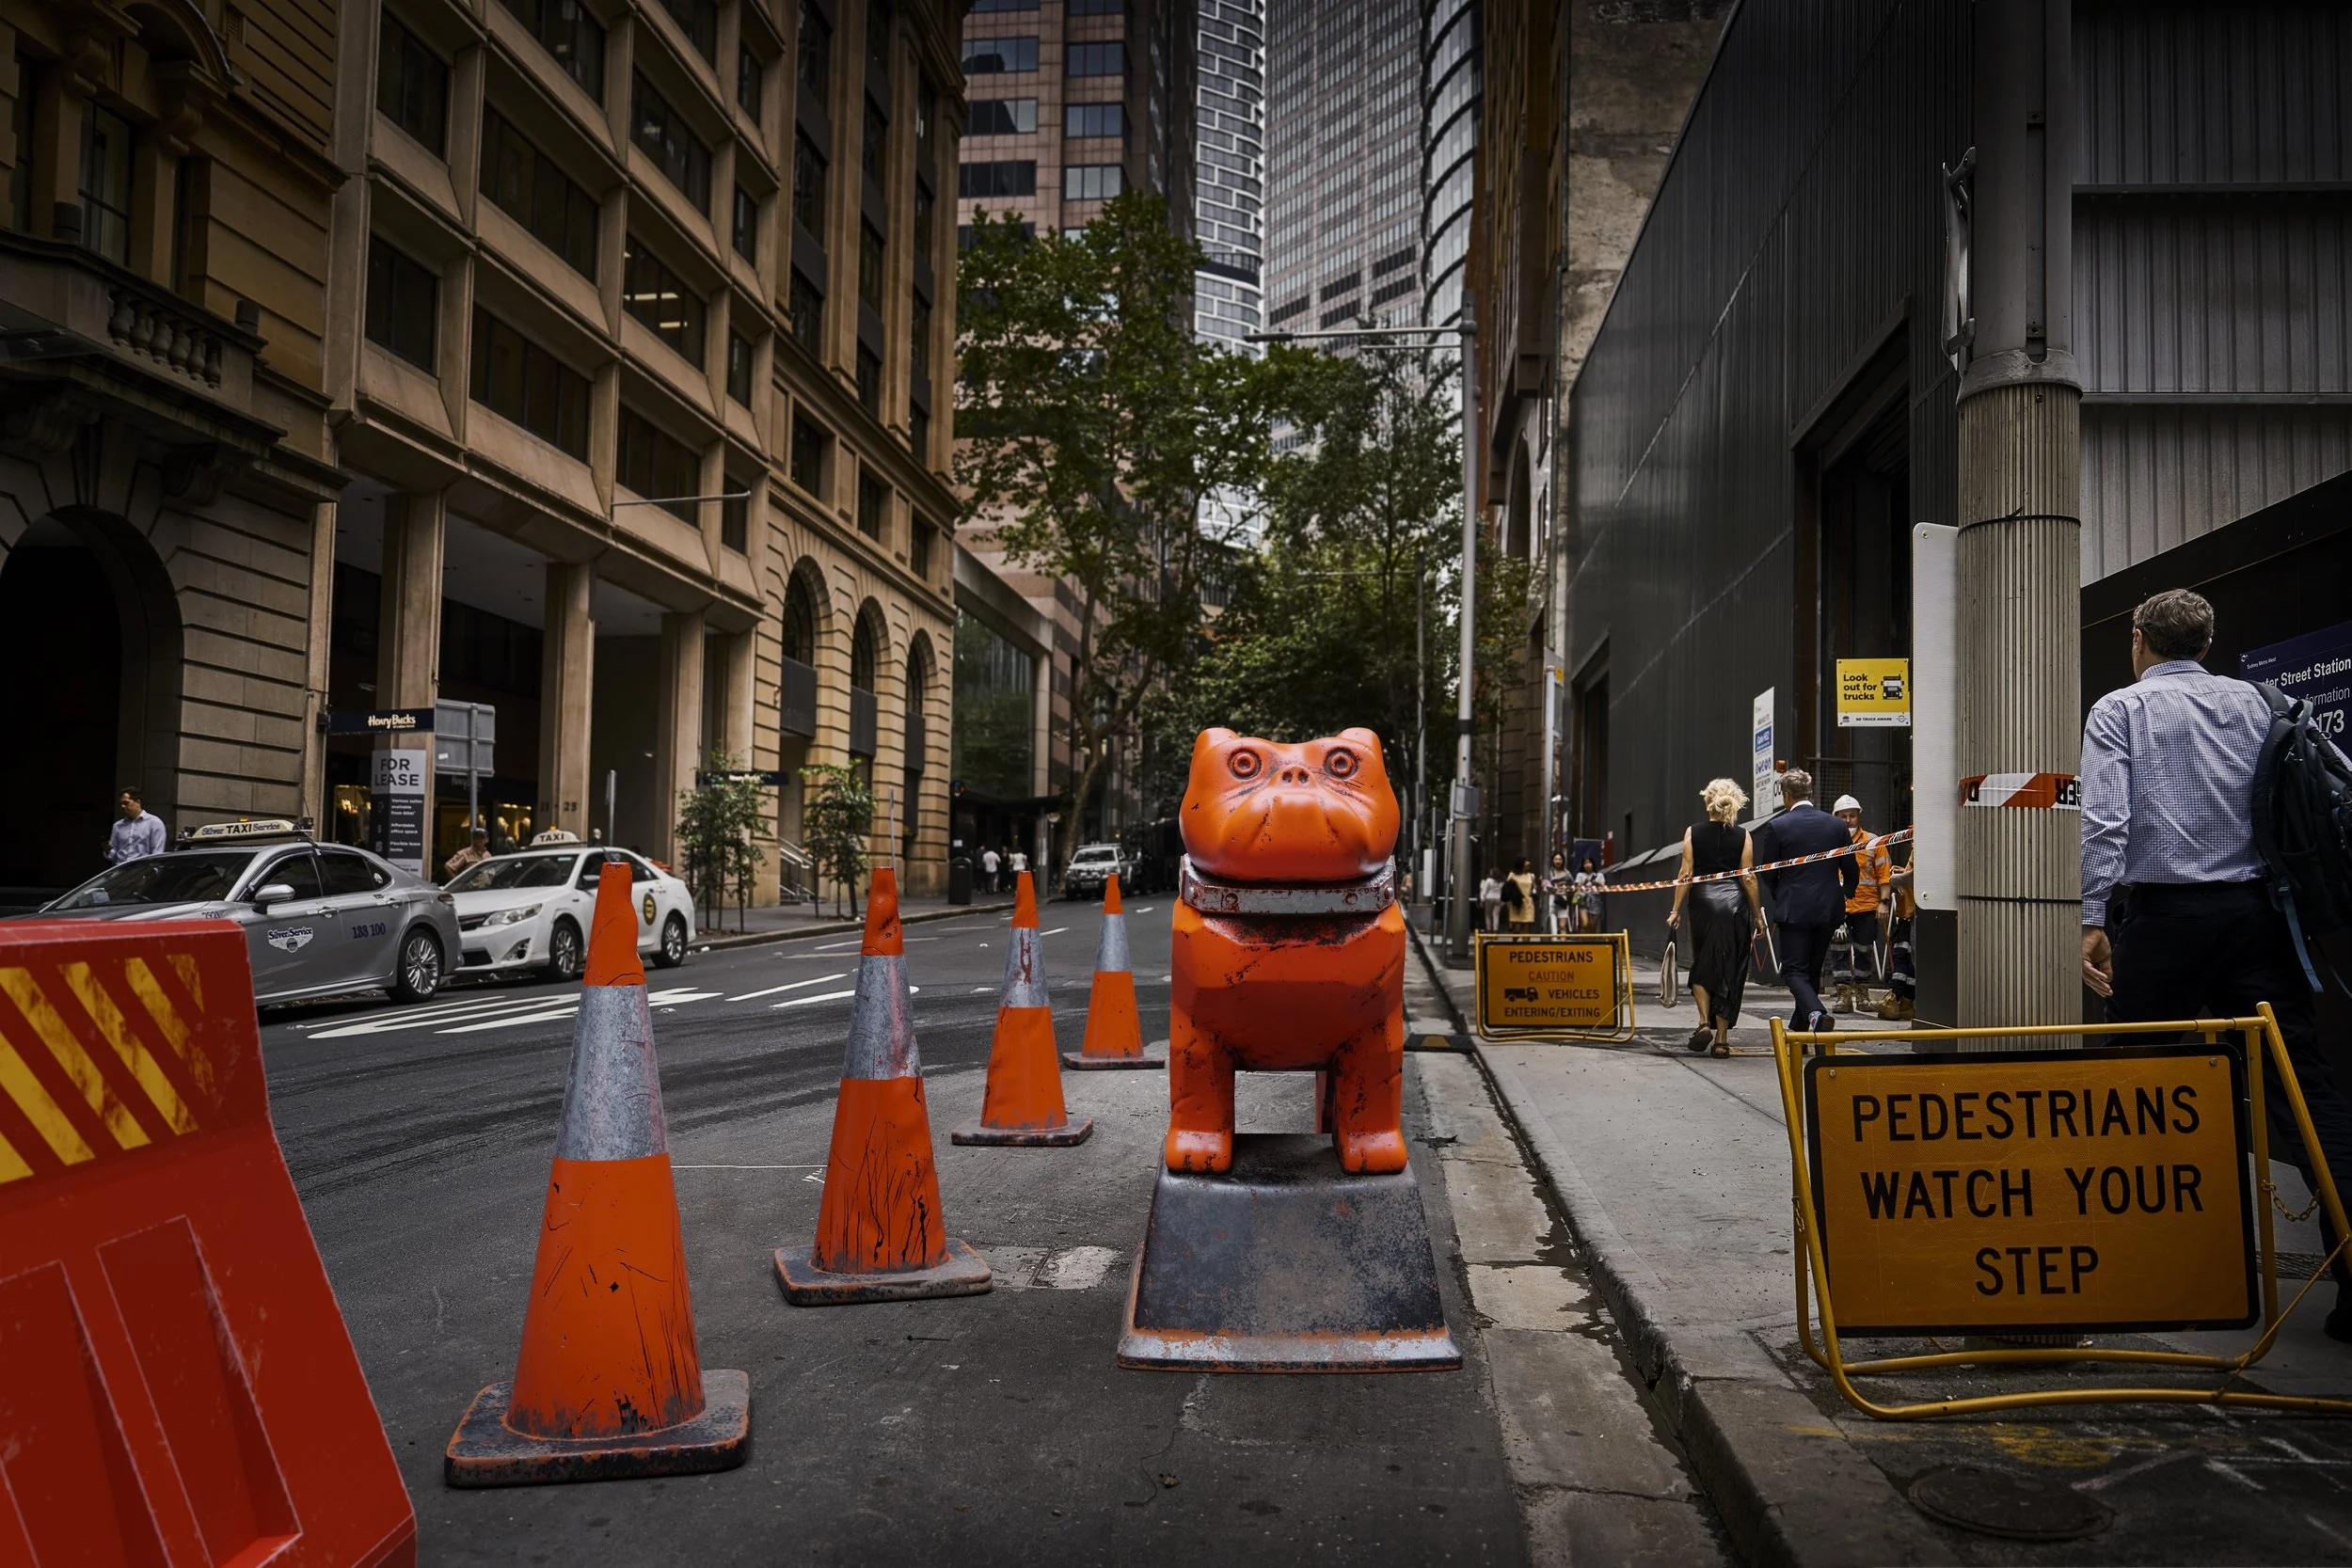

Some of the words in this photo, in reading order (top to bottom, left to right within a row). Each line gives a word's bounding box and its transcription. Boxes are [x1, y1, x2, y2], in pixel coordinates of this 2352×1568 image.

[2247, 660, 2258, 670] Sydney
[2258, 657, 2268, 667] Metro
[1843, 673, 1868, 682] Look
[2280, 666, 2312, 687] Street
[2313, 657, 2351, 678] Station
[1843, 692, 1875, 701] trucks
[368, 715, 392, 729] Henry
[391, 714, 416, 726] Bucks
[2316, 709, 2344, 734] 173
[380, 758, 410, 771] FOR
[374, 773, 420, 786] LEASE
[226, 824, 252, 834] TAXI
[539, 832, 564, 843] TAXI
[268, 929, 288, 940] Silver
[289, 927, 312, 938] Service
[369, 922, 386, 936] 100
[1509, 951, 1594, 963] PEDESTRIANS
[1528, 971, 1575, 981] CAUTION
[1548, 989, 1599, 1000] VEHICLES
[1504, 1006, 1600, 1018] ENTERING/EXITING
[1851, 1084, 2201, 1143] PEDESTRIANS
[1860, 1167, 2033, 1220] WATCH
[2063, 1163, 2204, 1215] YOUR
[1975, 1244, 2101, 1297] STEP
